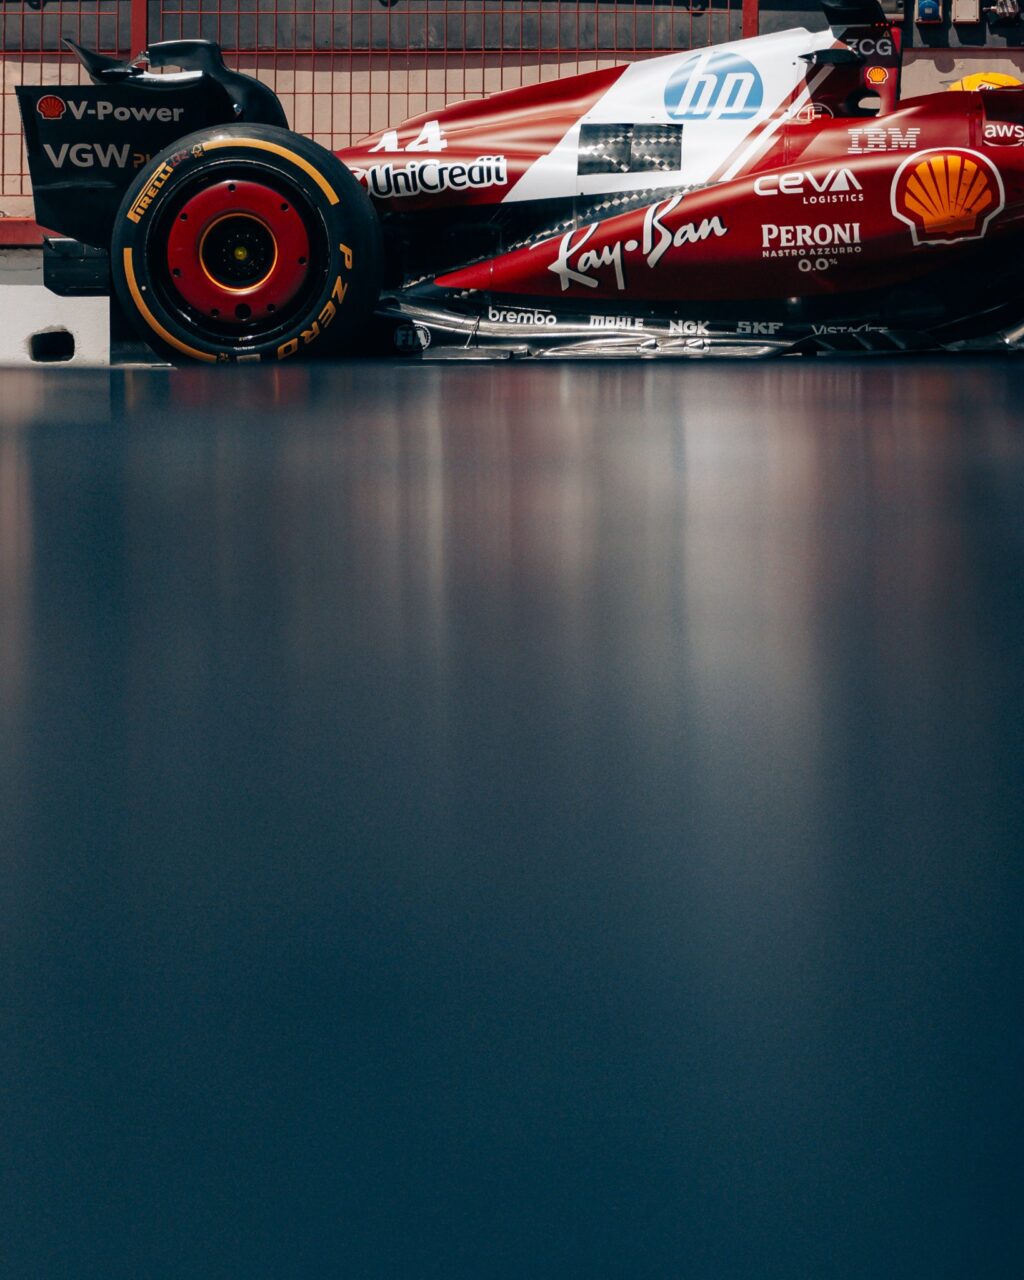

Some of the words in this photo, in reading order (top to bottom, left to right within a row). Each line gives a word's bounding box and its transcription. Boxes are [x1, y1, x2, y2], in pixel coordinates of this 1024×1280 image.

[673, 50, 755, 120] hp
[66, 100, 185, 122] V-Power
[847, 127, 921, 154] IBM
[984, 123, 1024, 138] aws
[43, 143, 131, 169] VGW
[369, 156, 507, 198] UniCredit
[126, 161, 174, 224] PIRELLI
[803, 194, 864, 204] LOGISTICS
[761, 223, 861, 247] PERONI
[762, 249, 806, 258] NASTRO
[809, 246, 862, 255] AZZURRO
[488, 306, 557, 326] brembo
[588, 315, 644, 330] MAHLE
[669, 320, 710, 336] NGK
[736, 321, 784, 335] SKF
